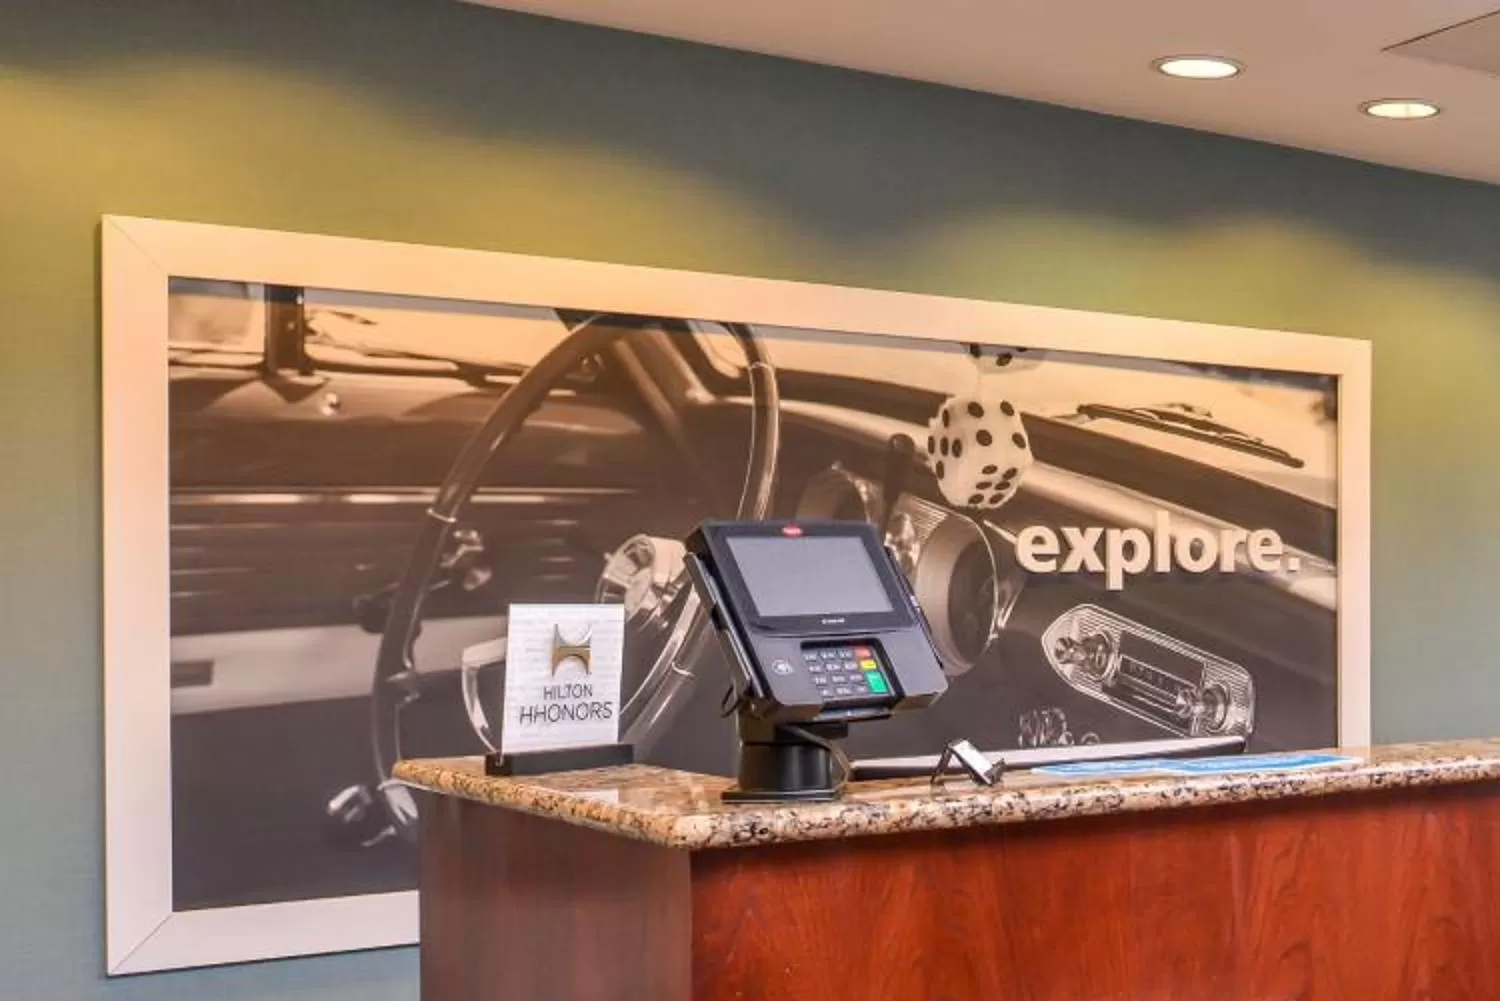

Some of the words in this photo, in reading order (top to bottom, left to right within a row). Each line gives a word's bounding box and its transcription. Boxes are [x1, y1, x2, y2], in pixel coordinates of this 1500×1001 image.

[1015, 510, 1301, 591] explore.
[543, 683, 594, 701] HILTON
[519, 701, 613, 726] HHONORS
